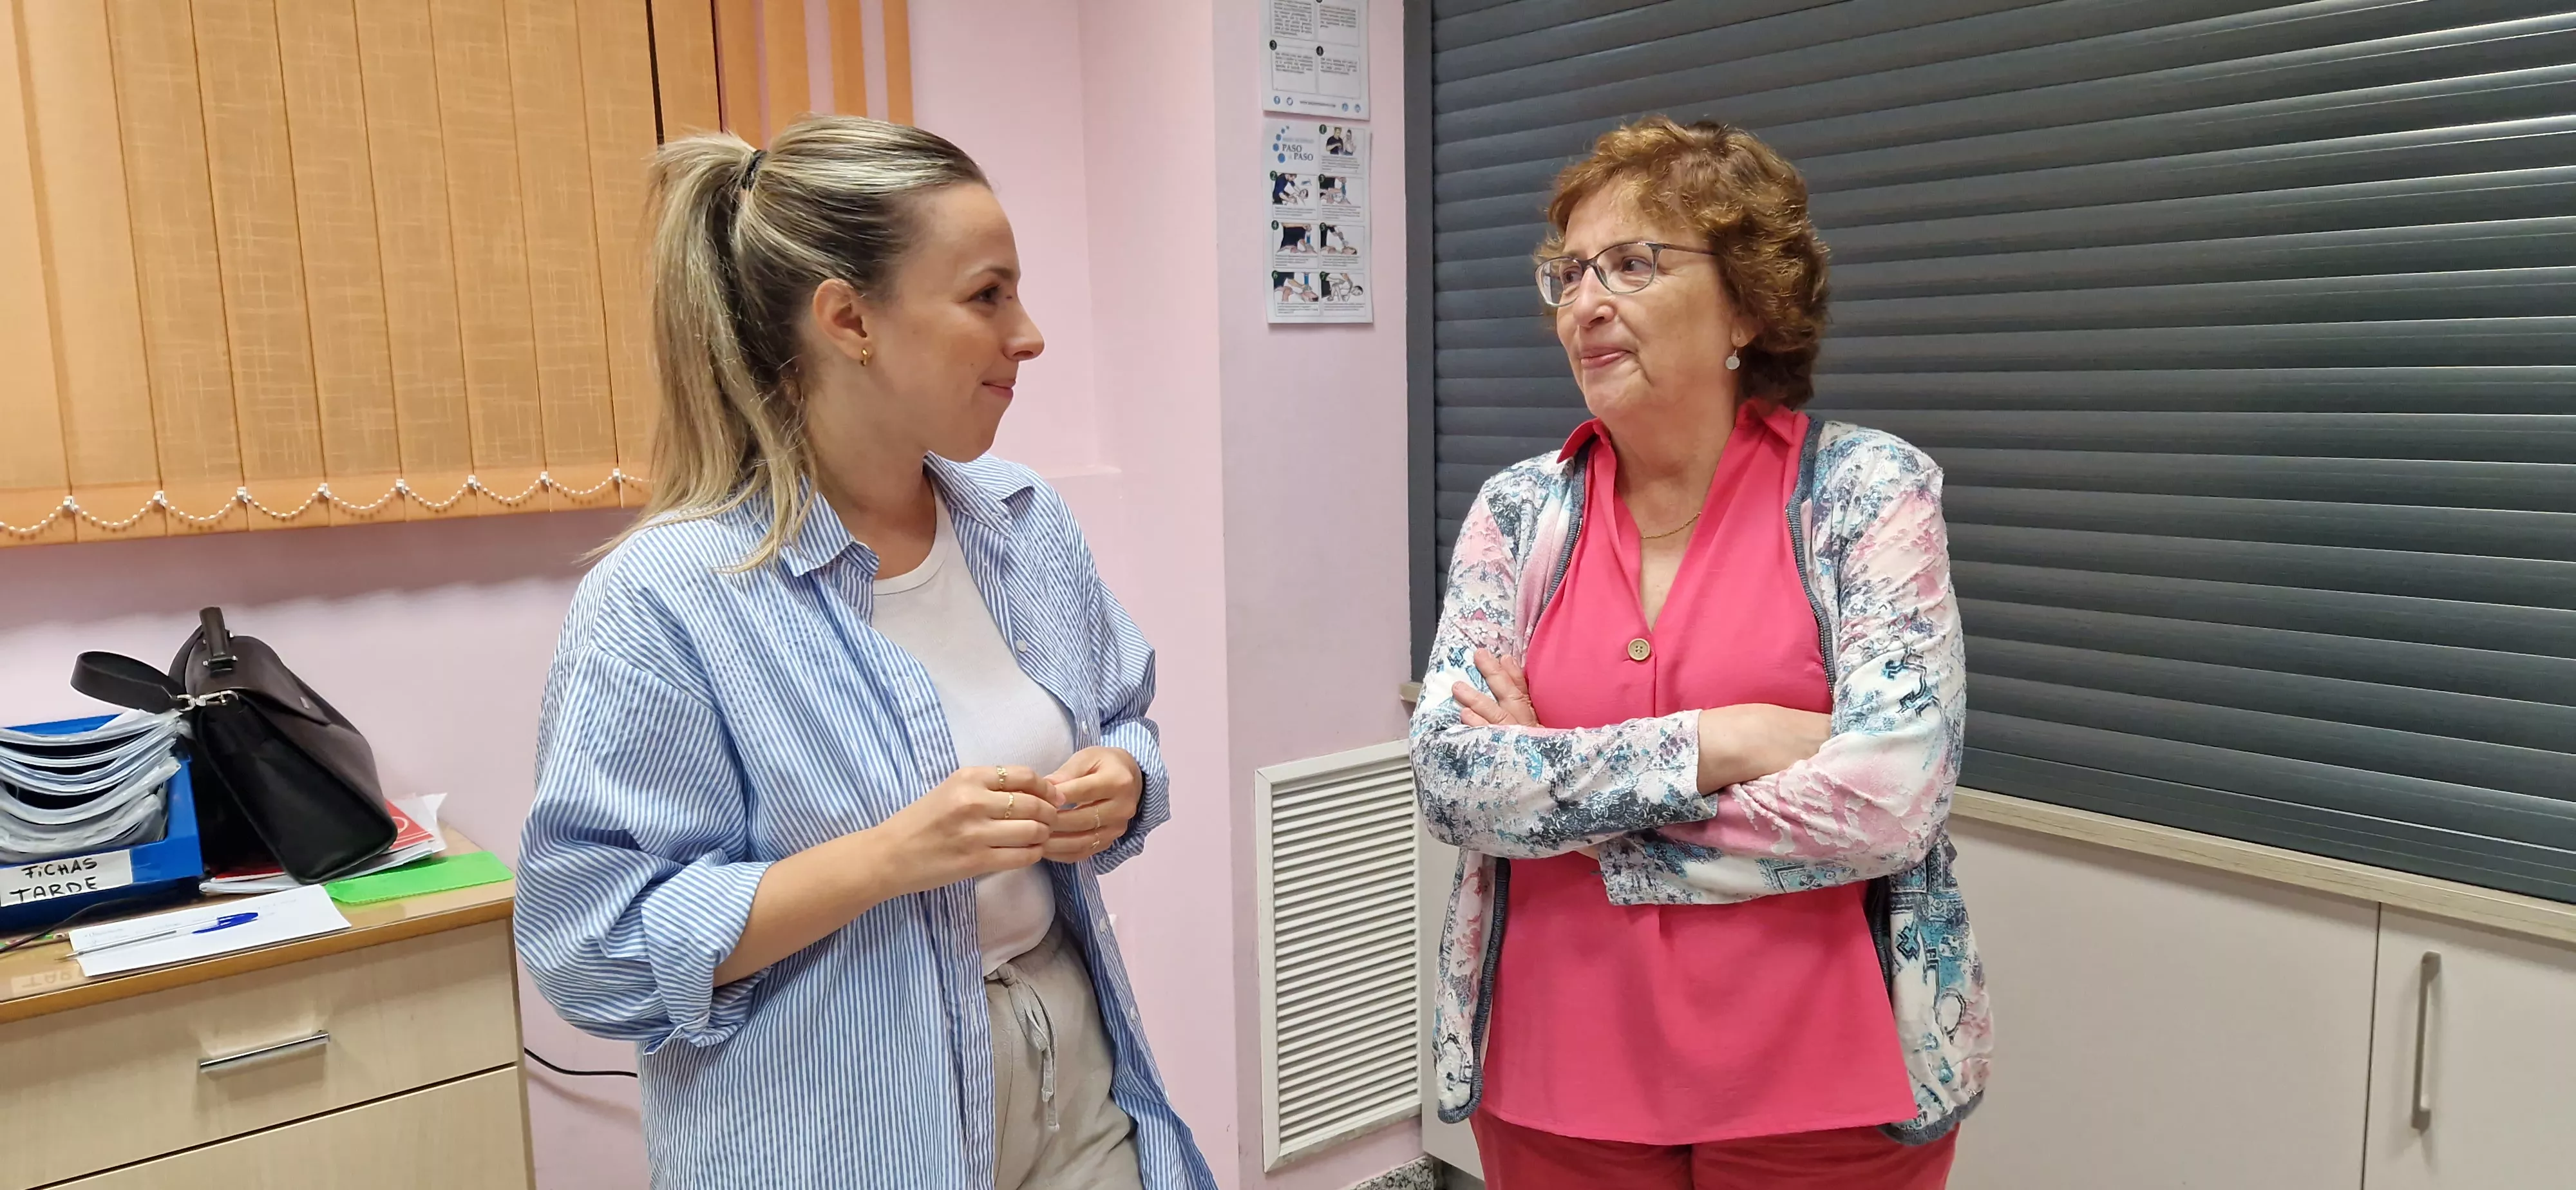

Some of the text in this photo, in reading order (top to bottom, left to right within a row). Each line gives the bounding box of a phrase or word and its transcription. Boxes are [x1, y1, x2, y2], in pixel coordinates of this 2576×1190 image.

[1282, 144, 1302, 153] PASO
[1294, 153, 1314, 161] PASO
[9, 876, 97, 902] TARDE
